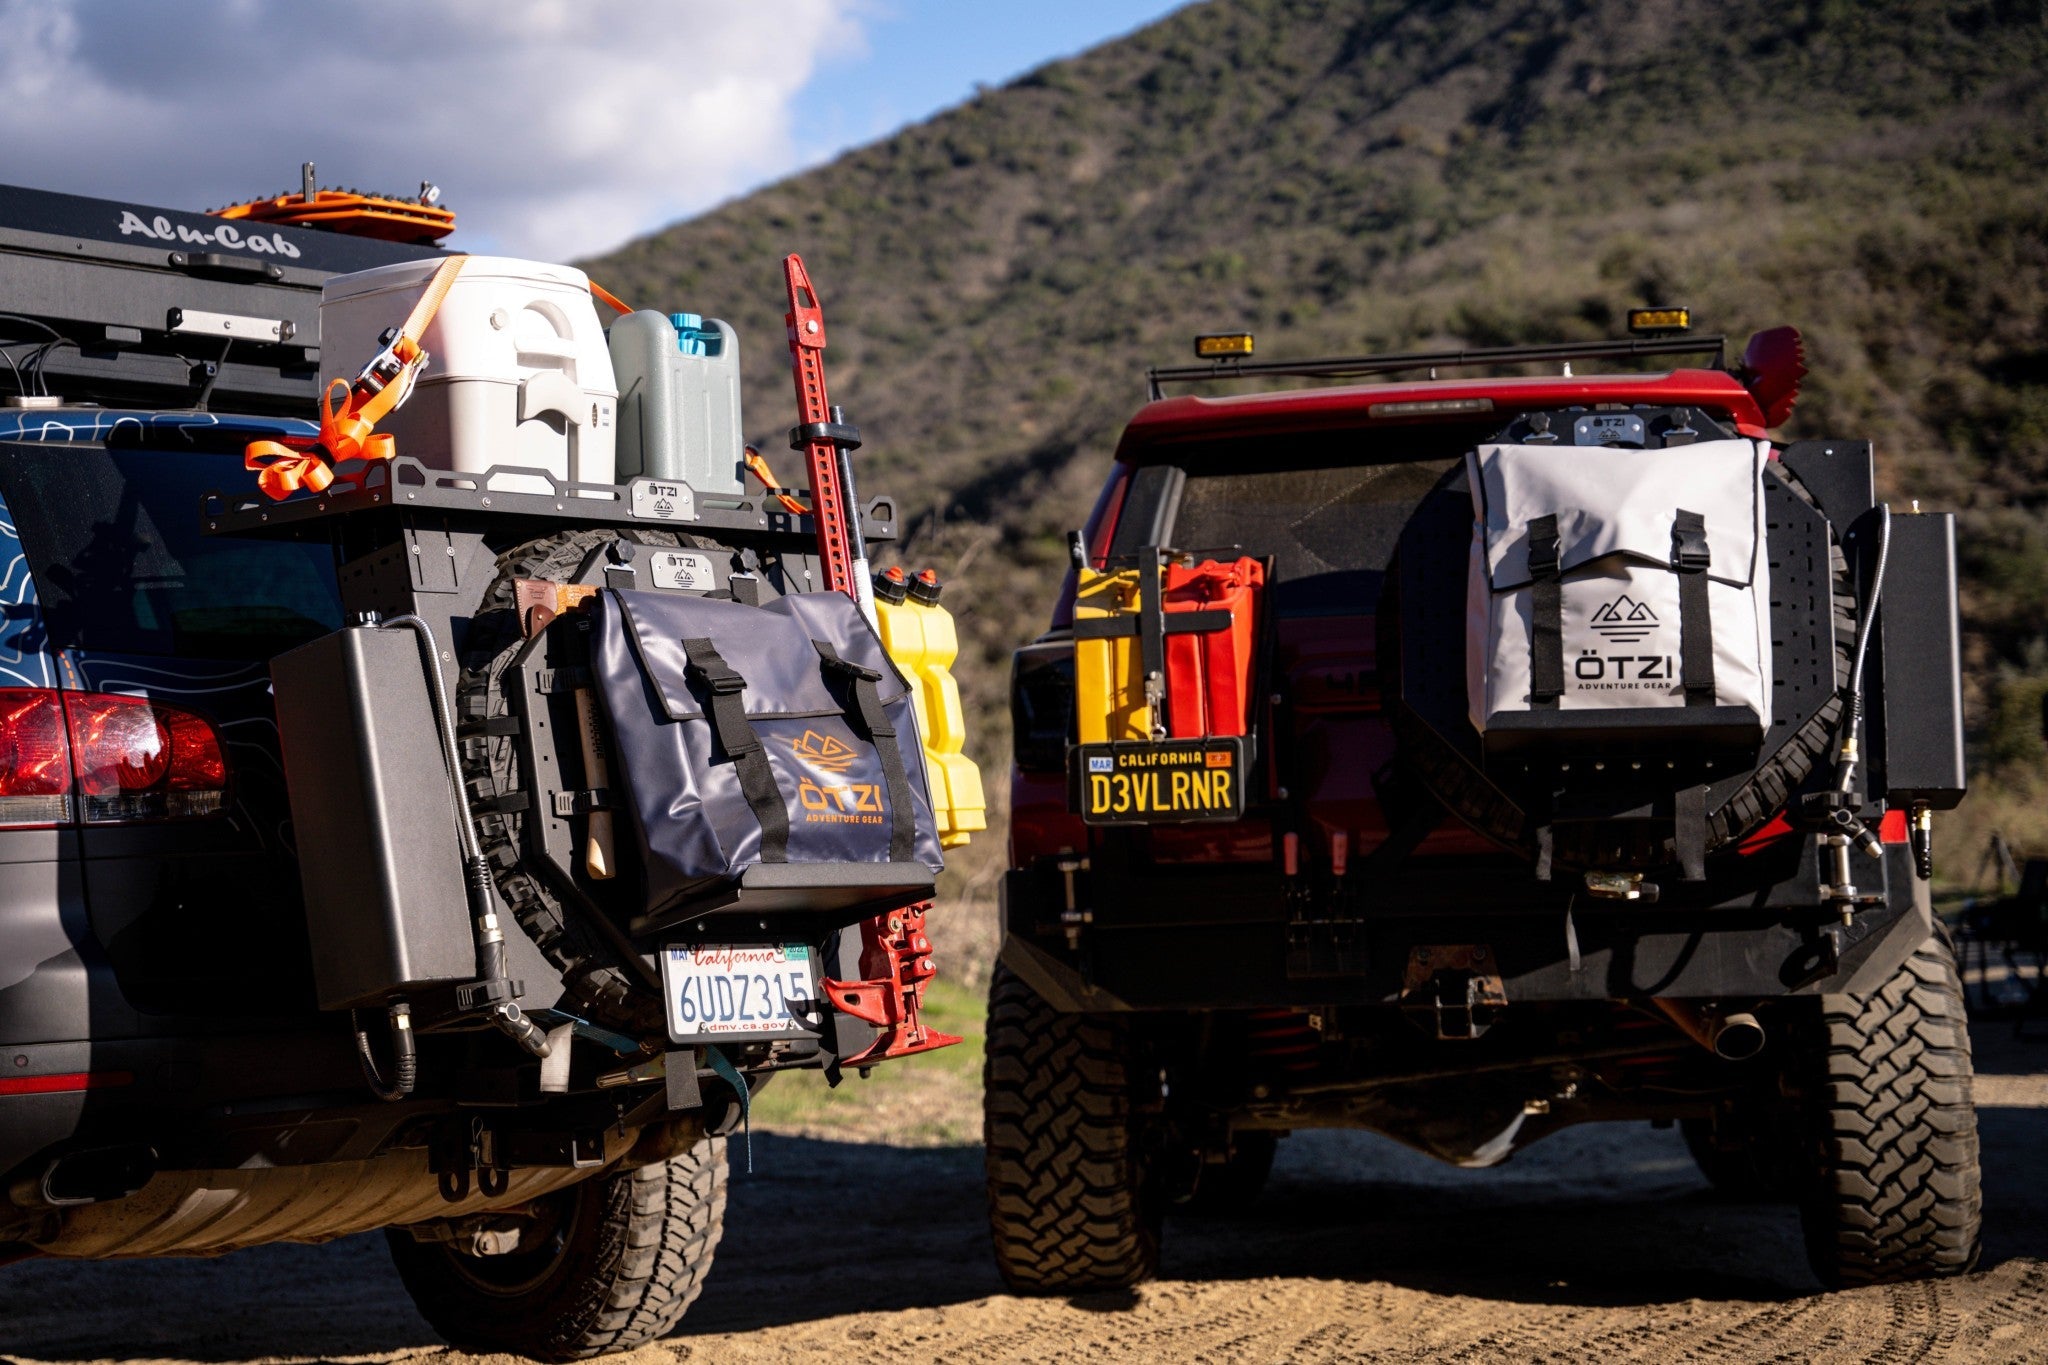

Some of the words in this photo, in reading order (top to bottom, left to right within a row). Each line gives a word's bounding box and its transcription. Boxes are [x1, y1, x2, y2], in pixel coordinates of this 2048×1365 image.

[119, 211, 301, 259] Alu-Cab
[1593, 416, 1625, 427] ÖTZI
[649, 483, 678, 497] ÖTZI
[667, 554, 696, 568] ÖTZI
[1575, 649, 1672, 680] ÖTZI
[1578, 682, 1640, 690] ADVENTURE
[1091, 759, 1112, 770] MAR
[1119, 751, 1203, 767] CALIFORNIA
[799, 775, 884, 812] ÖTZI
[1090, 770, 1232, 814] D3VLRNR
[805, 813, 859, 824] ADVENTURE
[862, 815, 883, 825] GEAR
[670, 948, 689, 961] MAY
[694, 944, 786, 973] California
[680, 972, 809, 1023] 6UDZ315
[709, 1021, 787, 1032] dmv.ca.gov
